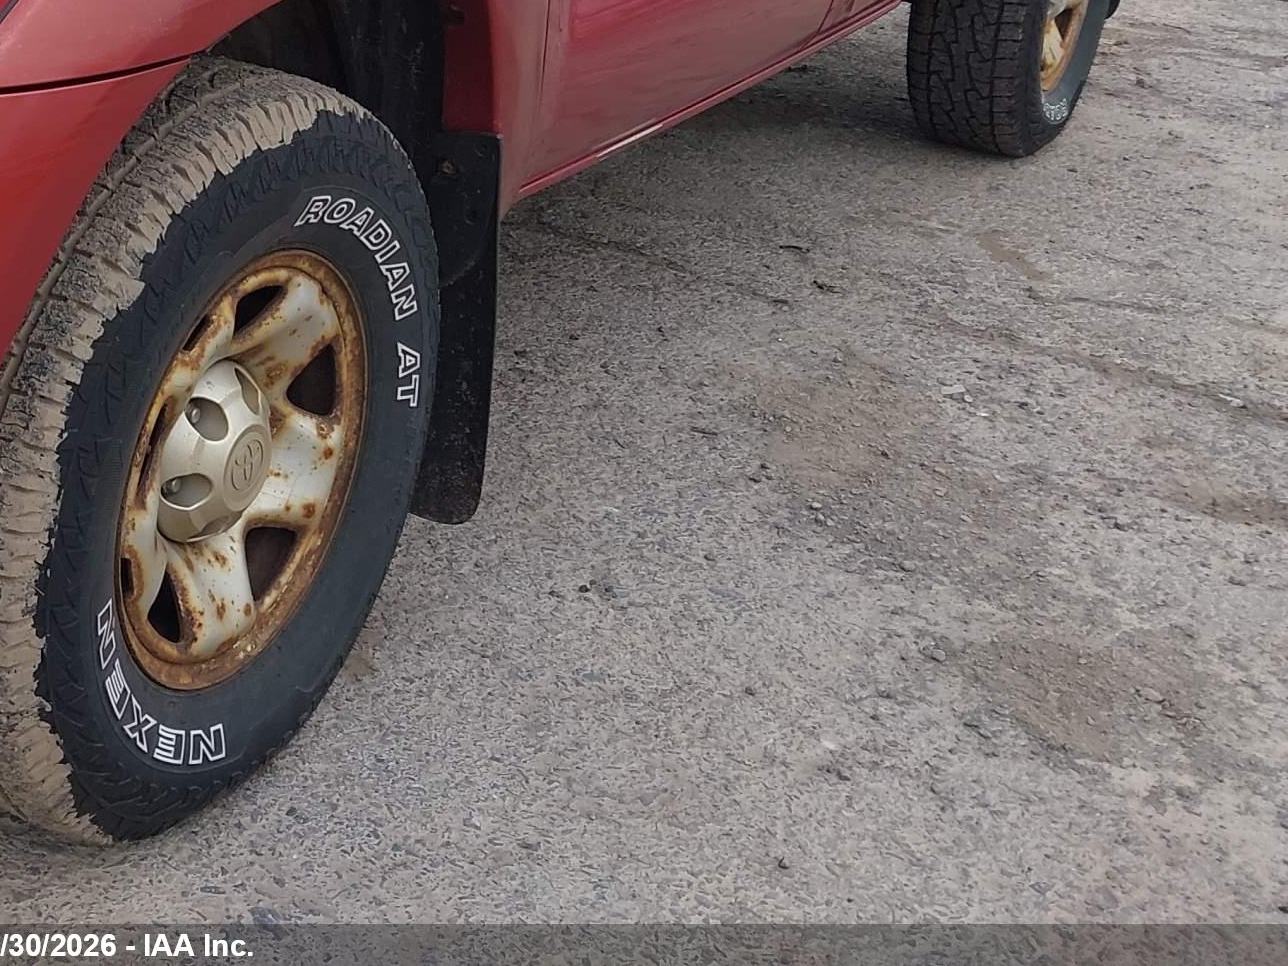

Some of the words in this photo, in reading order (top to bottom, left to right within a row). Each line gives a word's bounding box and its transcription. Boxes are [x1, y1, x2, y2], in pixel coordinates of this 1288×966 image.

[294, 194, 418, 321] ROADIAN
[396, 341, 420, 407] AT
[97, 597, 226, 765] NEXEN
